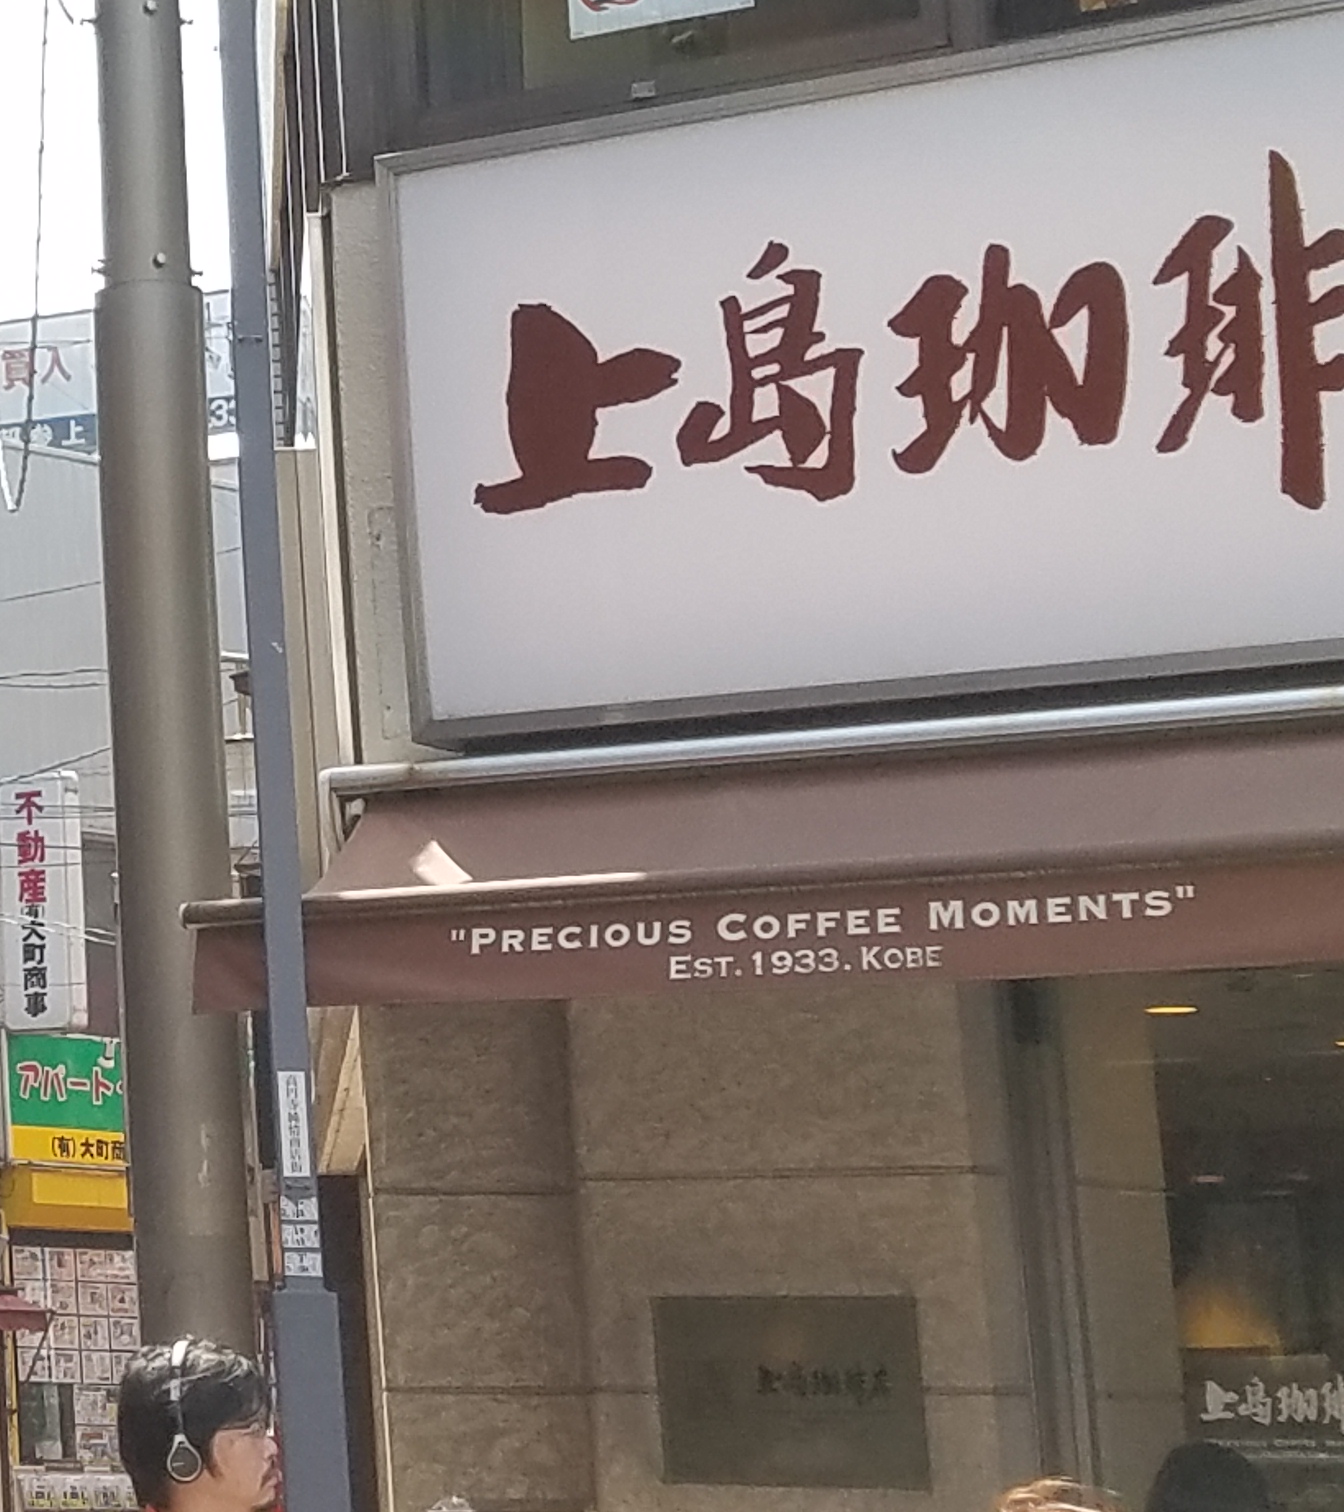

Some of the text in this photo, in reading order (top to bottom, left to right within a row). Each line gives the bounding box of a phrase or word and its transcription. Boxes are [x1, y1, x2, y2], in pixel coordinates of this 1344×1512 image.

[14, 790, 47, 904] 不動産
[717, 907, 903, 943] COFFEE
